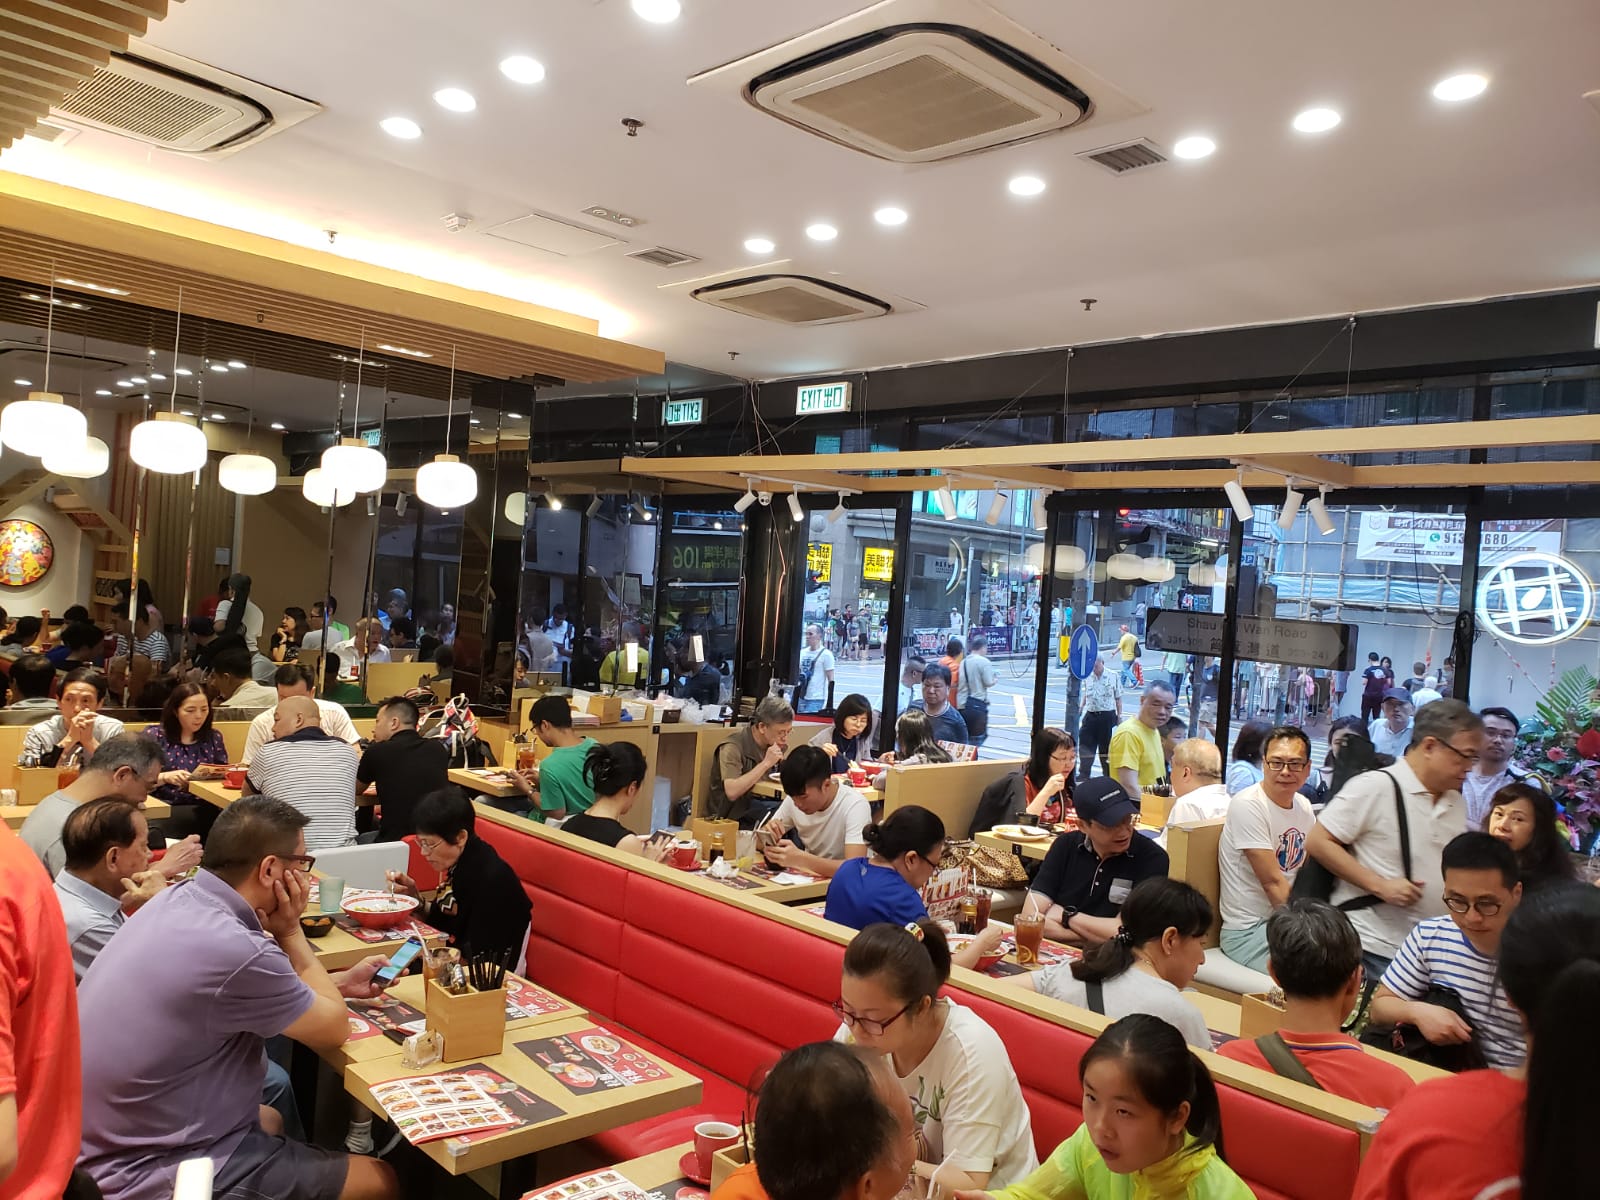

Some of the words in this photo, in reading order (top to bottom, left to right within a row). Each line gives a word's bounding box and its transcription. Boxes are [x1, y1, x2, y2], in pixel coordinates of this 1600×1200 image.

[801, 389, 823, 411] EXIT
[824, 387, 843, 408] 出口
[1187, 617, 1217, 630] Shau
[1243, 623, 1269, 635] Wan
[1274, 625, 1308, 639] Road
